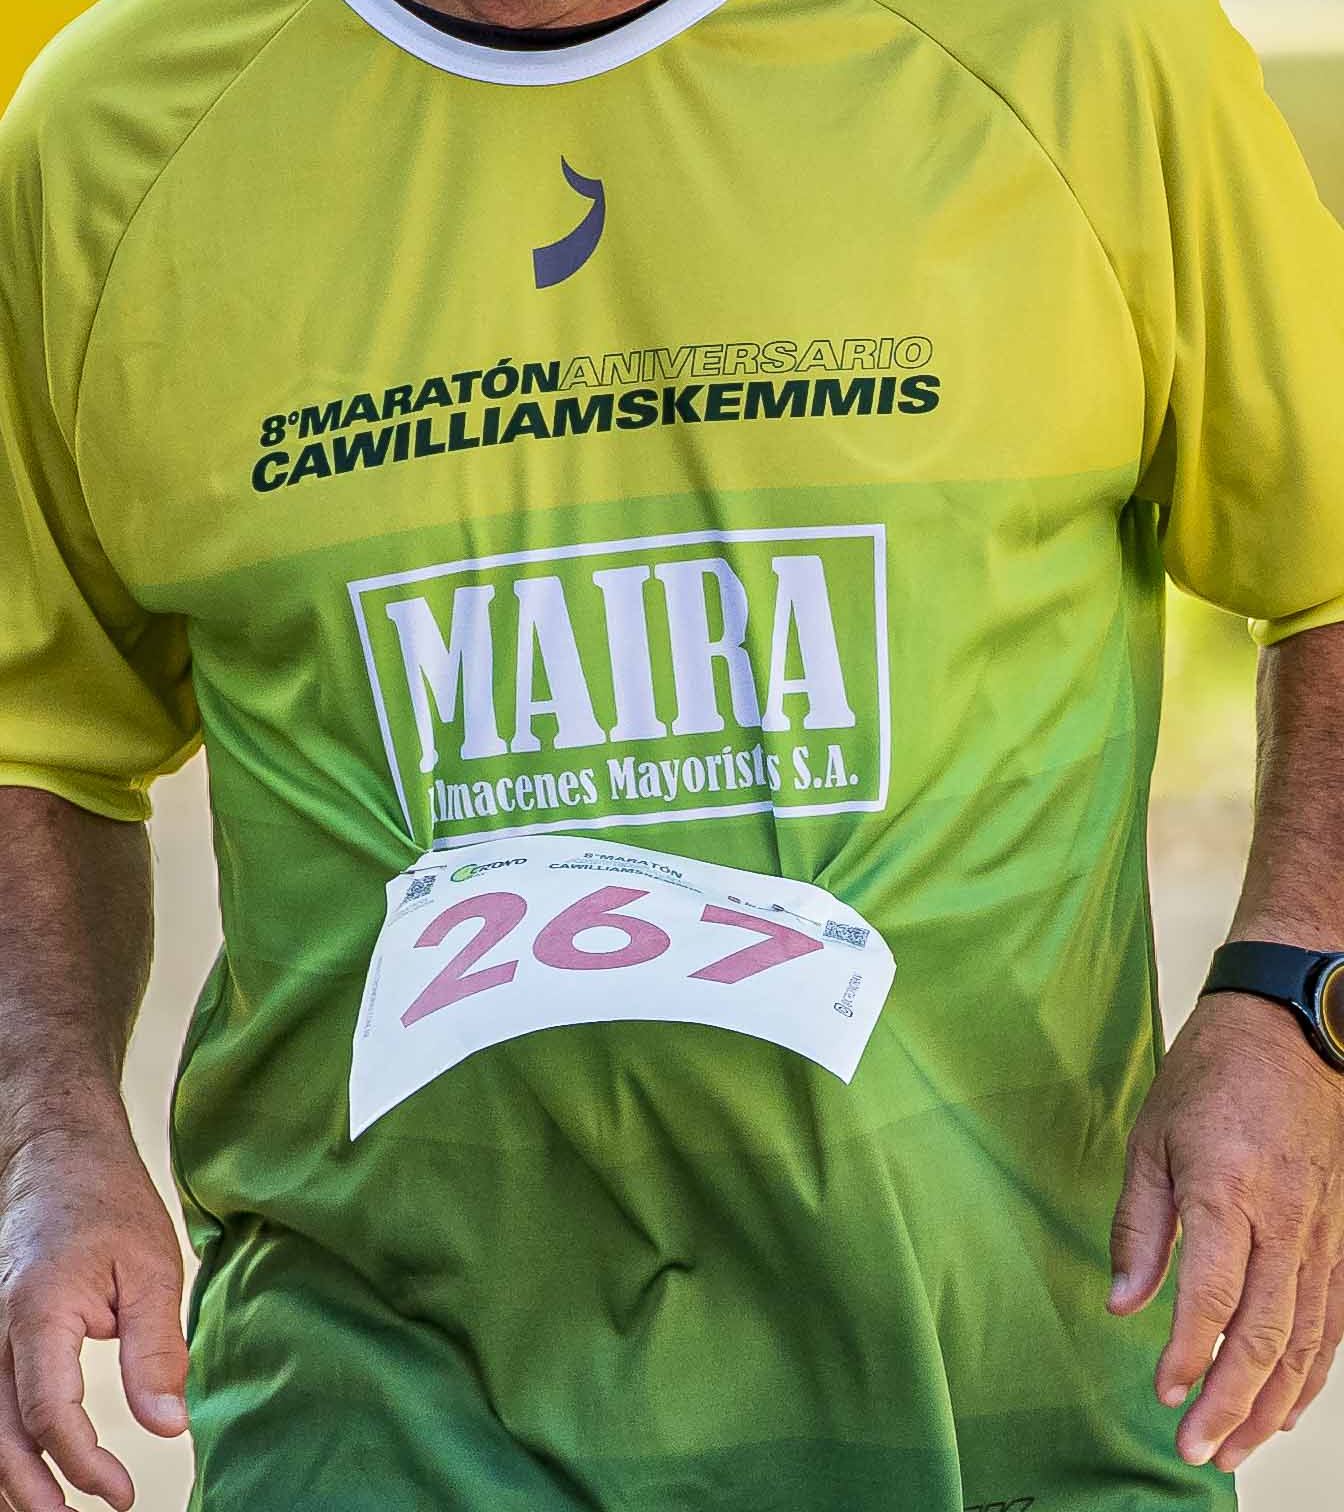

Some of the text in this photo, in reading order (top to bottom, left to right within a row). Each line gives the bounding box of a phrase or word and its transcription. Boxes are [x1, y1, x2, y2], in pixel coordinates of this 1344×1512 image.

[251, 374, 941, 493] CAWILLIAMSKEMMIS
[385, 554, 856, 774] MAIRA
[791, 743, 860, 791] S.A.
[399, 886, 826, 1030] 267
